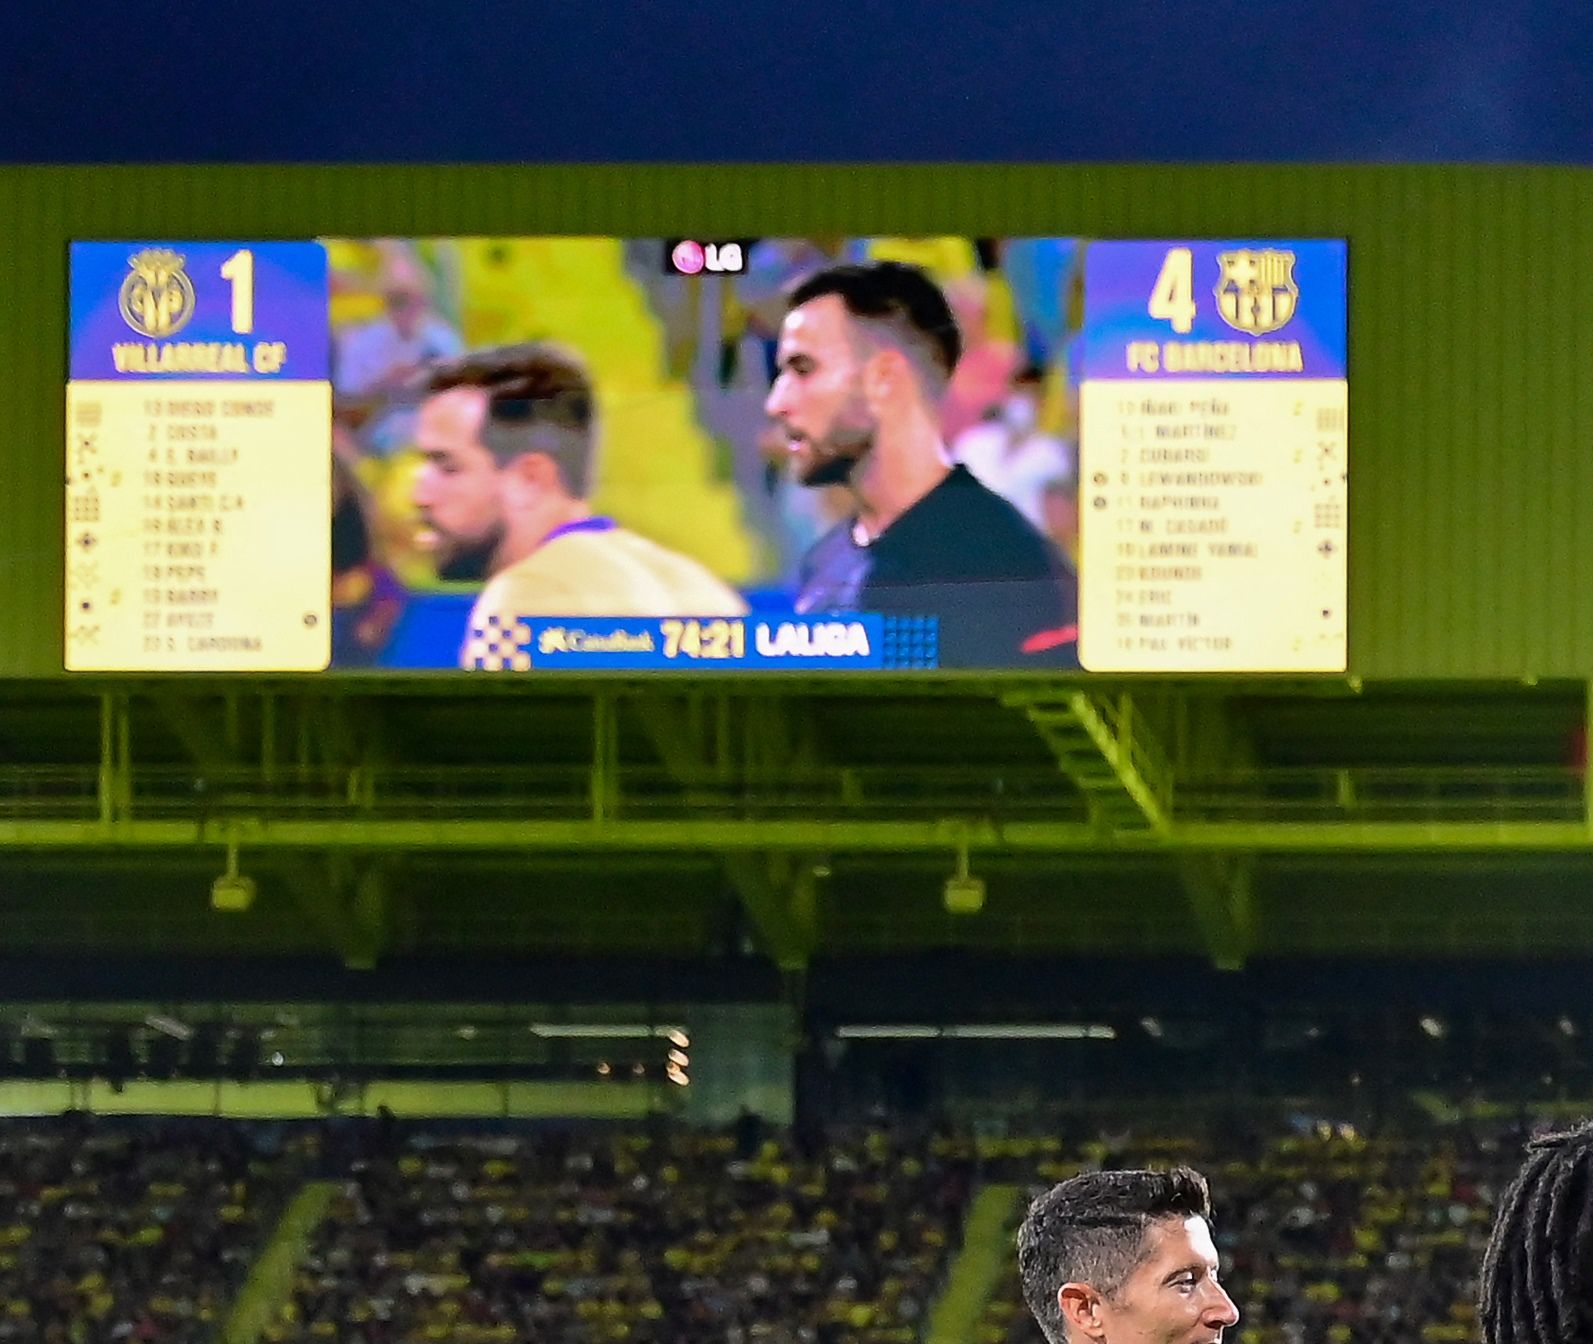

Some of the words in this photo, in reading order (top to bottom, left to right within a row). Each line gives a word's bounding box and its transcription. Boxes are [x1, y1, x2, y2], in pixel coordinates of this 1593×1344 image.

[704, 243, 743, 272] LG
[219, 248, 254, 335] 1
[1147, 247, 1197, 335] 4
[112, 342, 249, 373] VILLARREAL
[252, 341, 288, 373] CF
[1126, 341, 1161, 373] FC
[1163, 340, 1305, 373] BARCELONA
[754, 621, 870, 658] LALIGA
